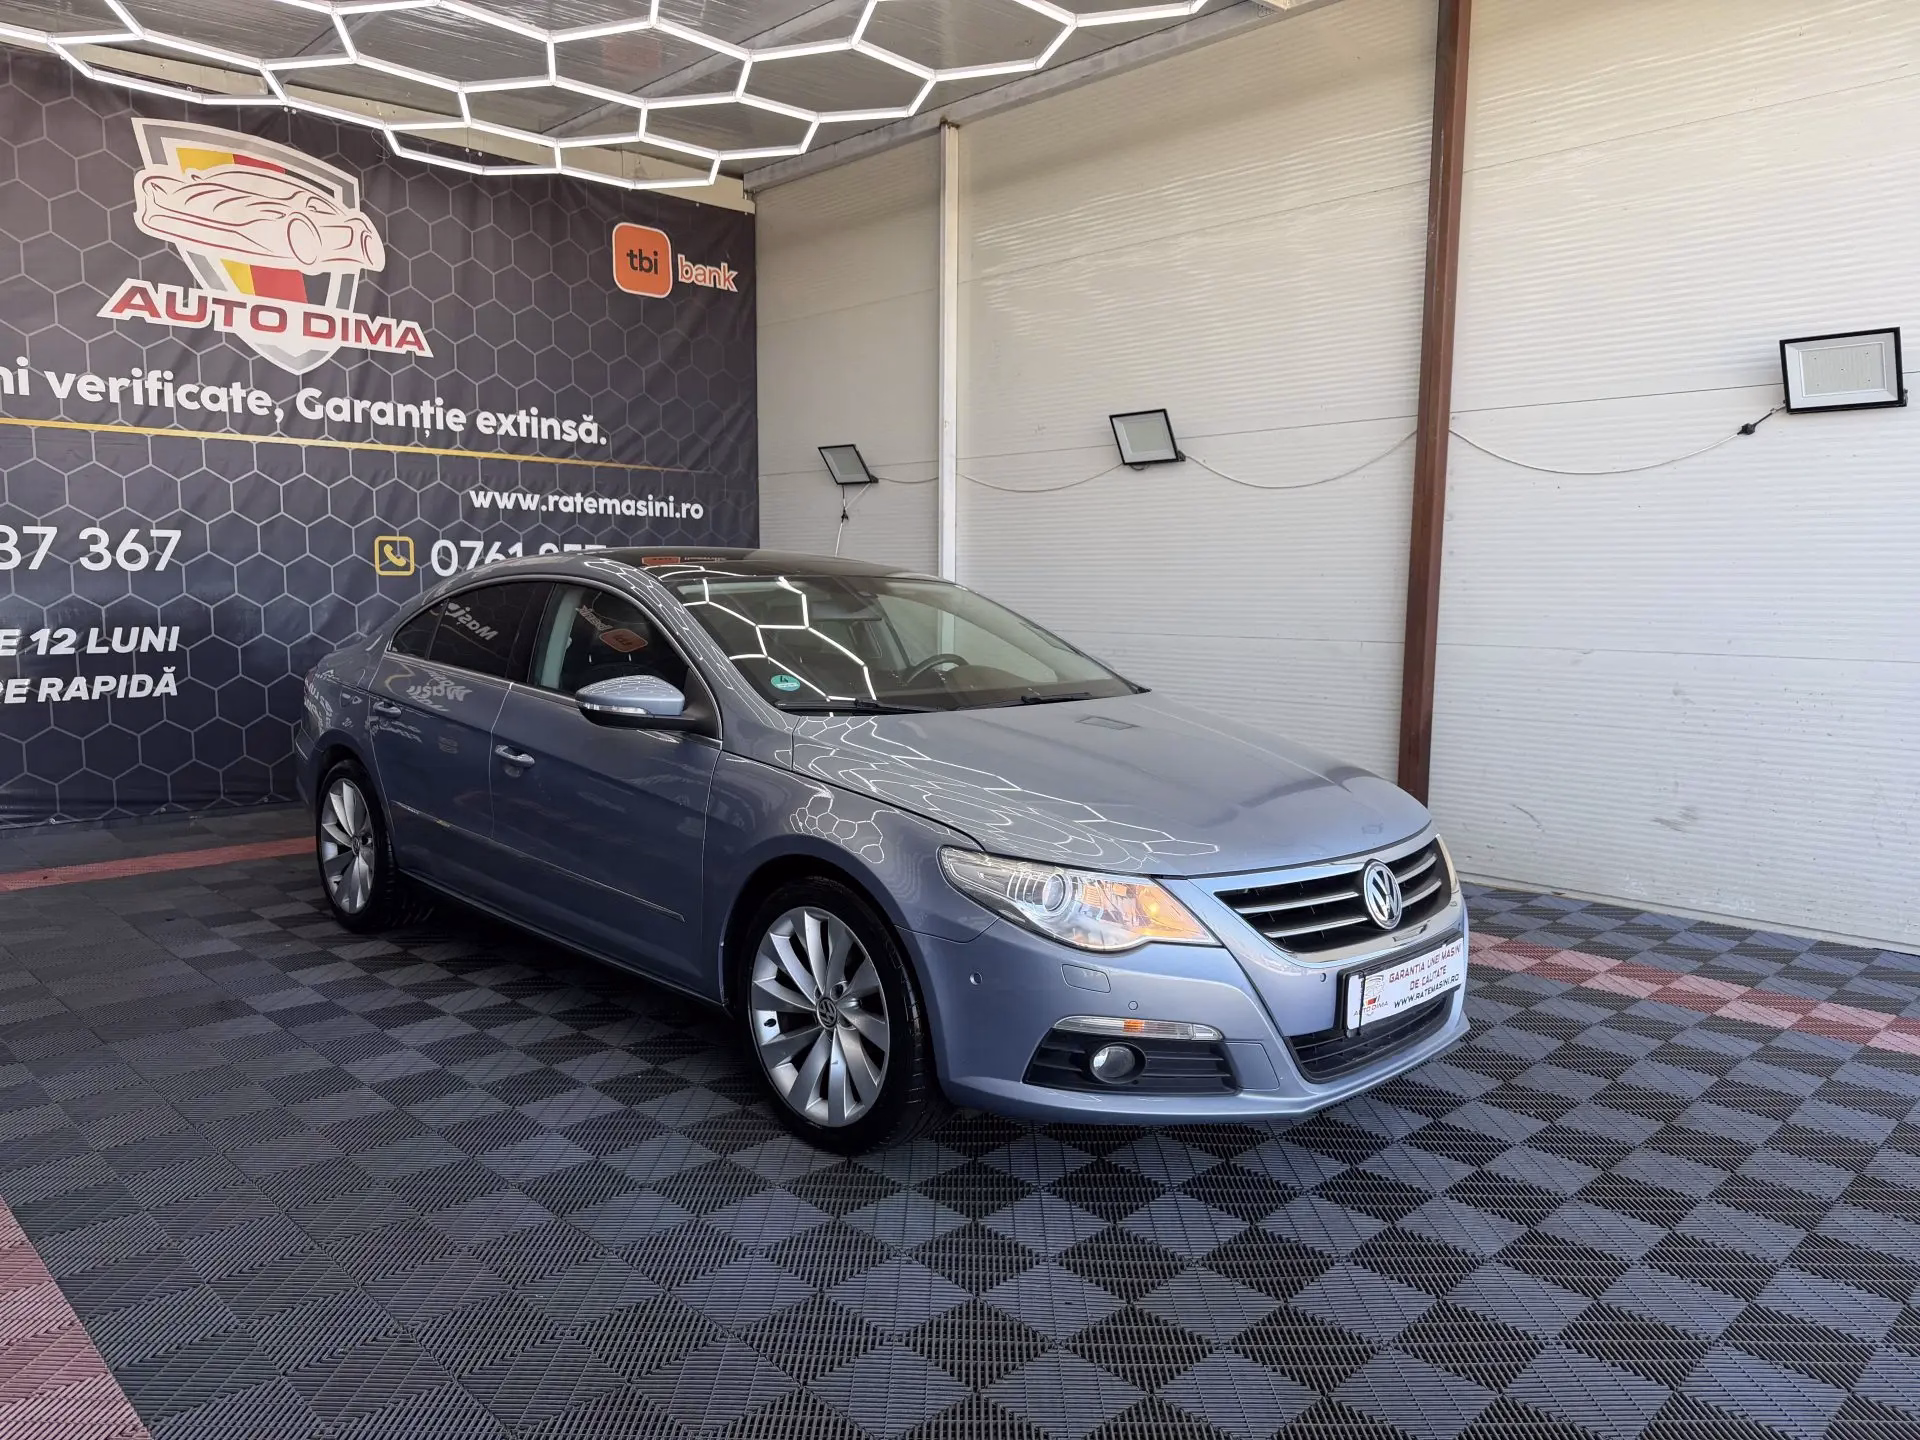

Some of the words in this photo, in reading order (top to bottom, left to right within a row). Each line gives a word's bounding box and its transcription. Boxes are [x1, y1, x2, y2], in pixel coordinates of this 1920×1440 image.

[626, 248, 659, 275] tbi
[677, 253, 739, 293] bank
[110, 284, 289, 334] AUTO
[302, 312, 427, 352] DIMA
[43, 366, 285, 424] verificate,
[296, 387, 468, 438] Garanție
[476, 406, 608, 446] extinsă.
[469, 489, 705, 520] www.ratemasini.ro
[79, 526, 183, 573] 367
[30, 627, 77, 656] 12
[86, 626, 181, 655] LUNI
[0, 678, 31, 704] E
[37, 666, 180, 703] RAPIDĂ
[1389, 961, 1425, 984] GARANTIA
